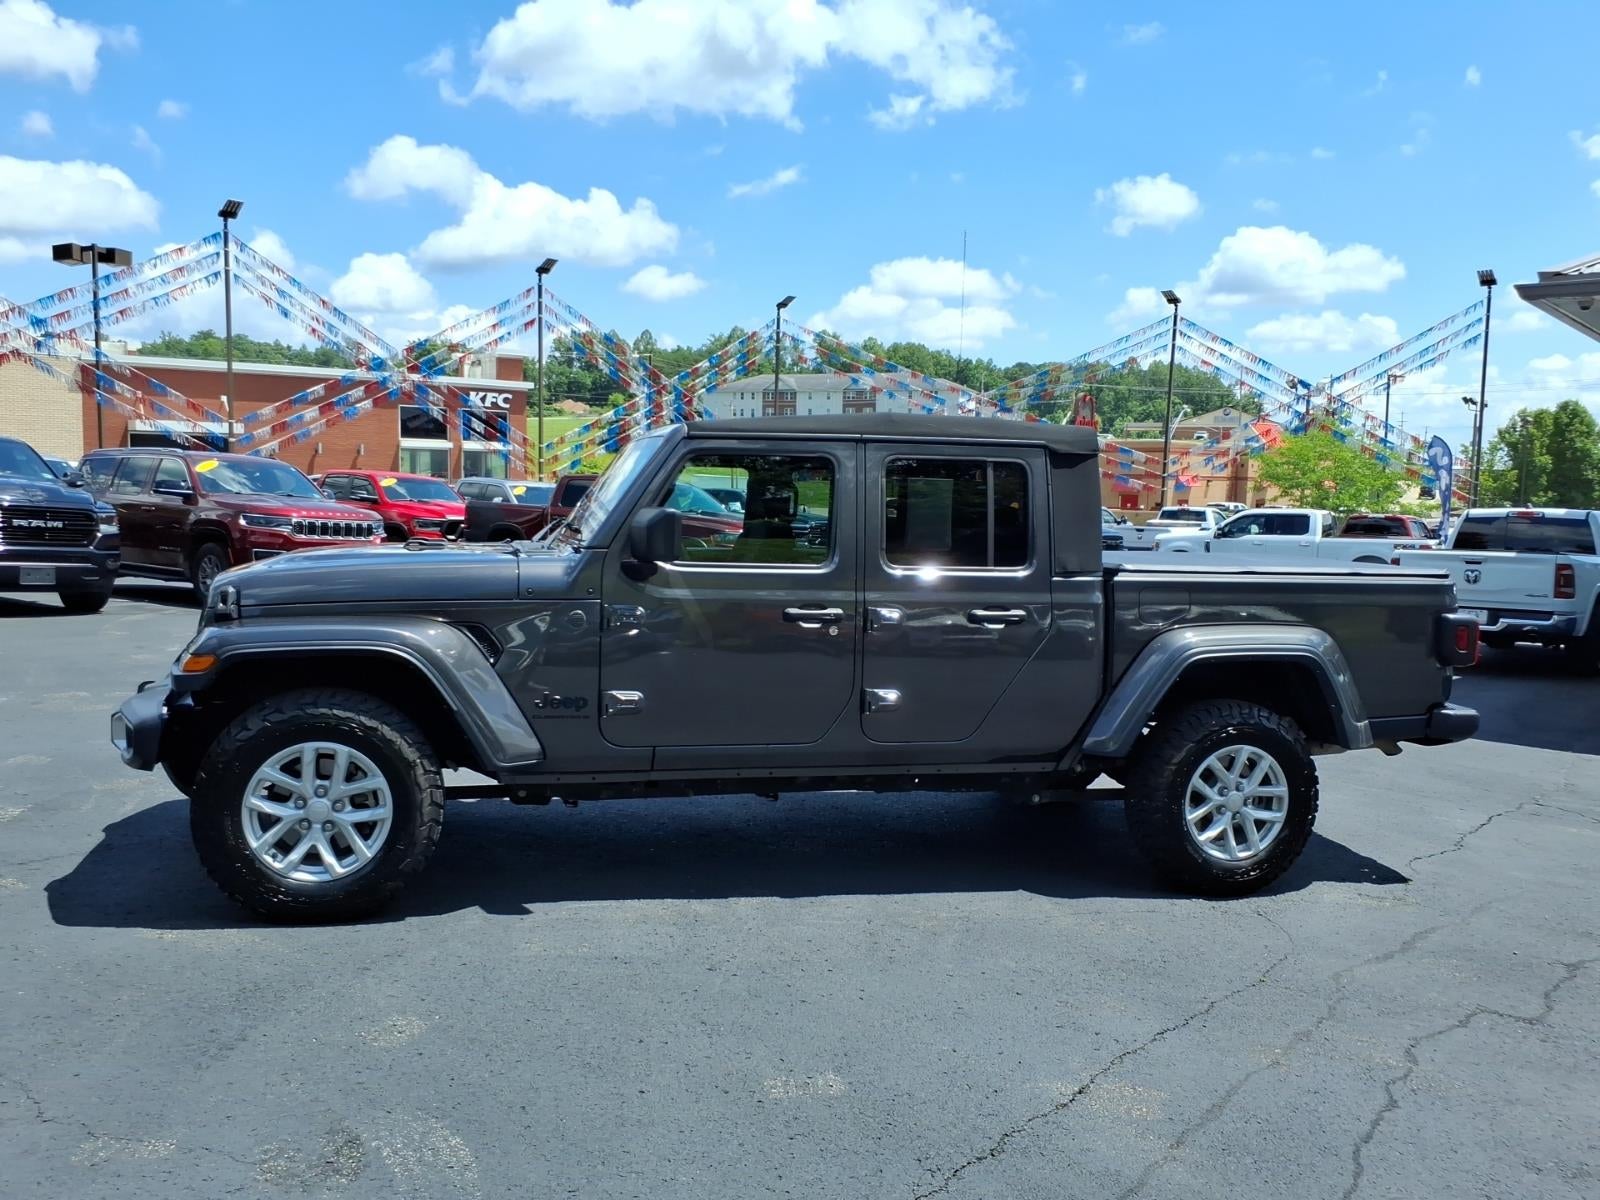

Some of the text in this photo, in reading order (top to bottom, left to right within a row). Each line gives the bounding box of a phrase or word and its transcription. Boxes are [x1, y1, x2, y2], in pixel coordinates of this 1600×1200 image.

[469, 391, 512, 408] KFC
[12, 519, 63, 528] RAM
[534, 690, 588, 712] Jeep
